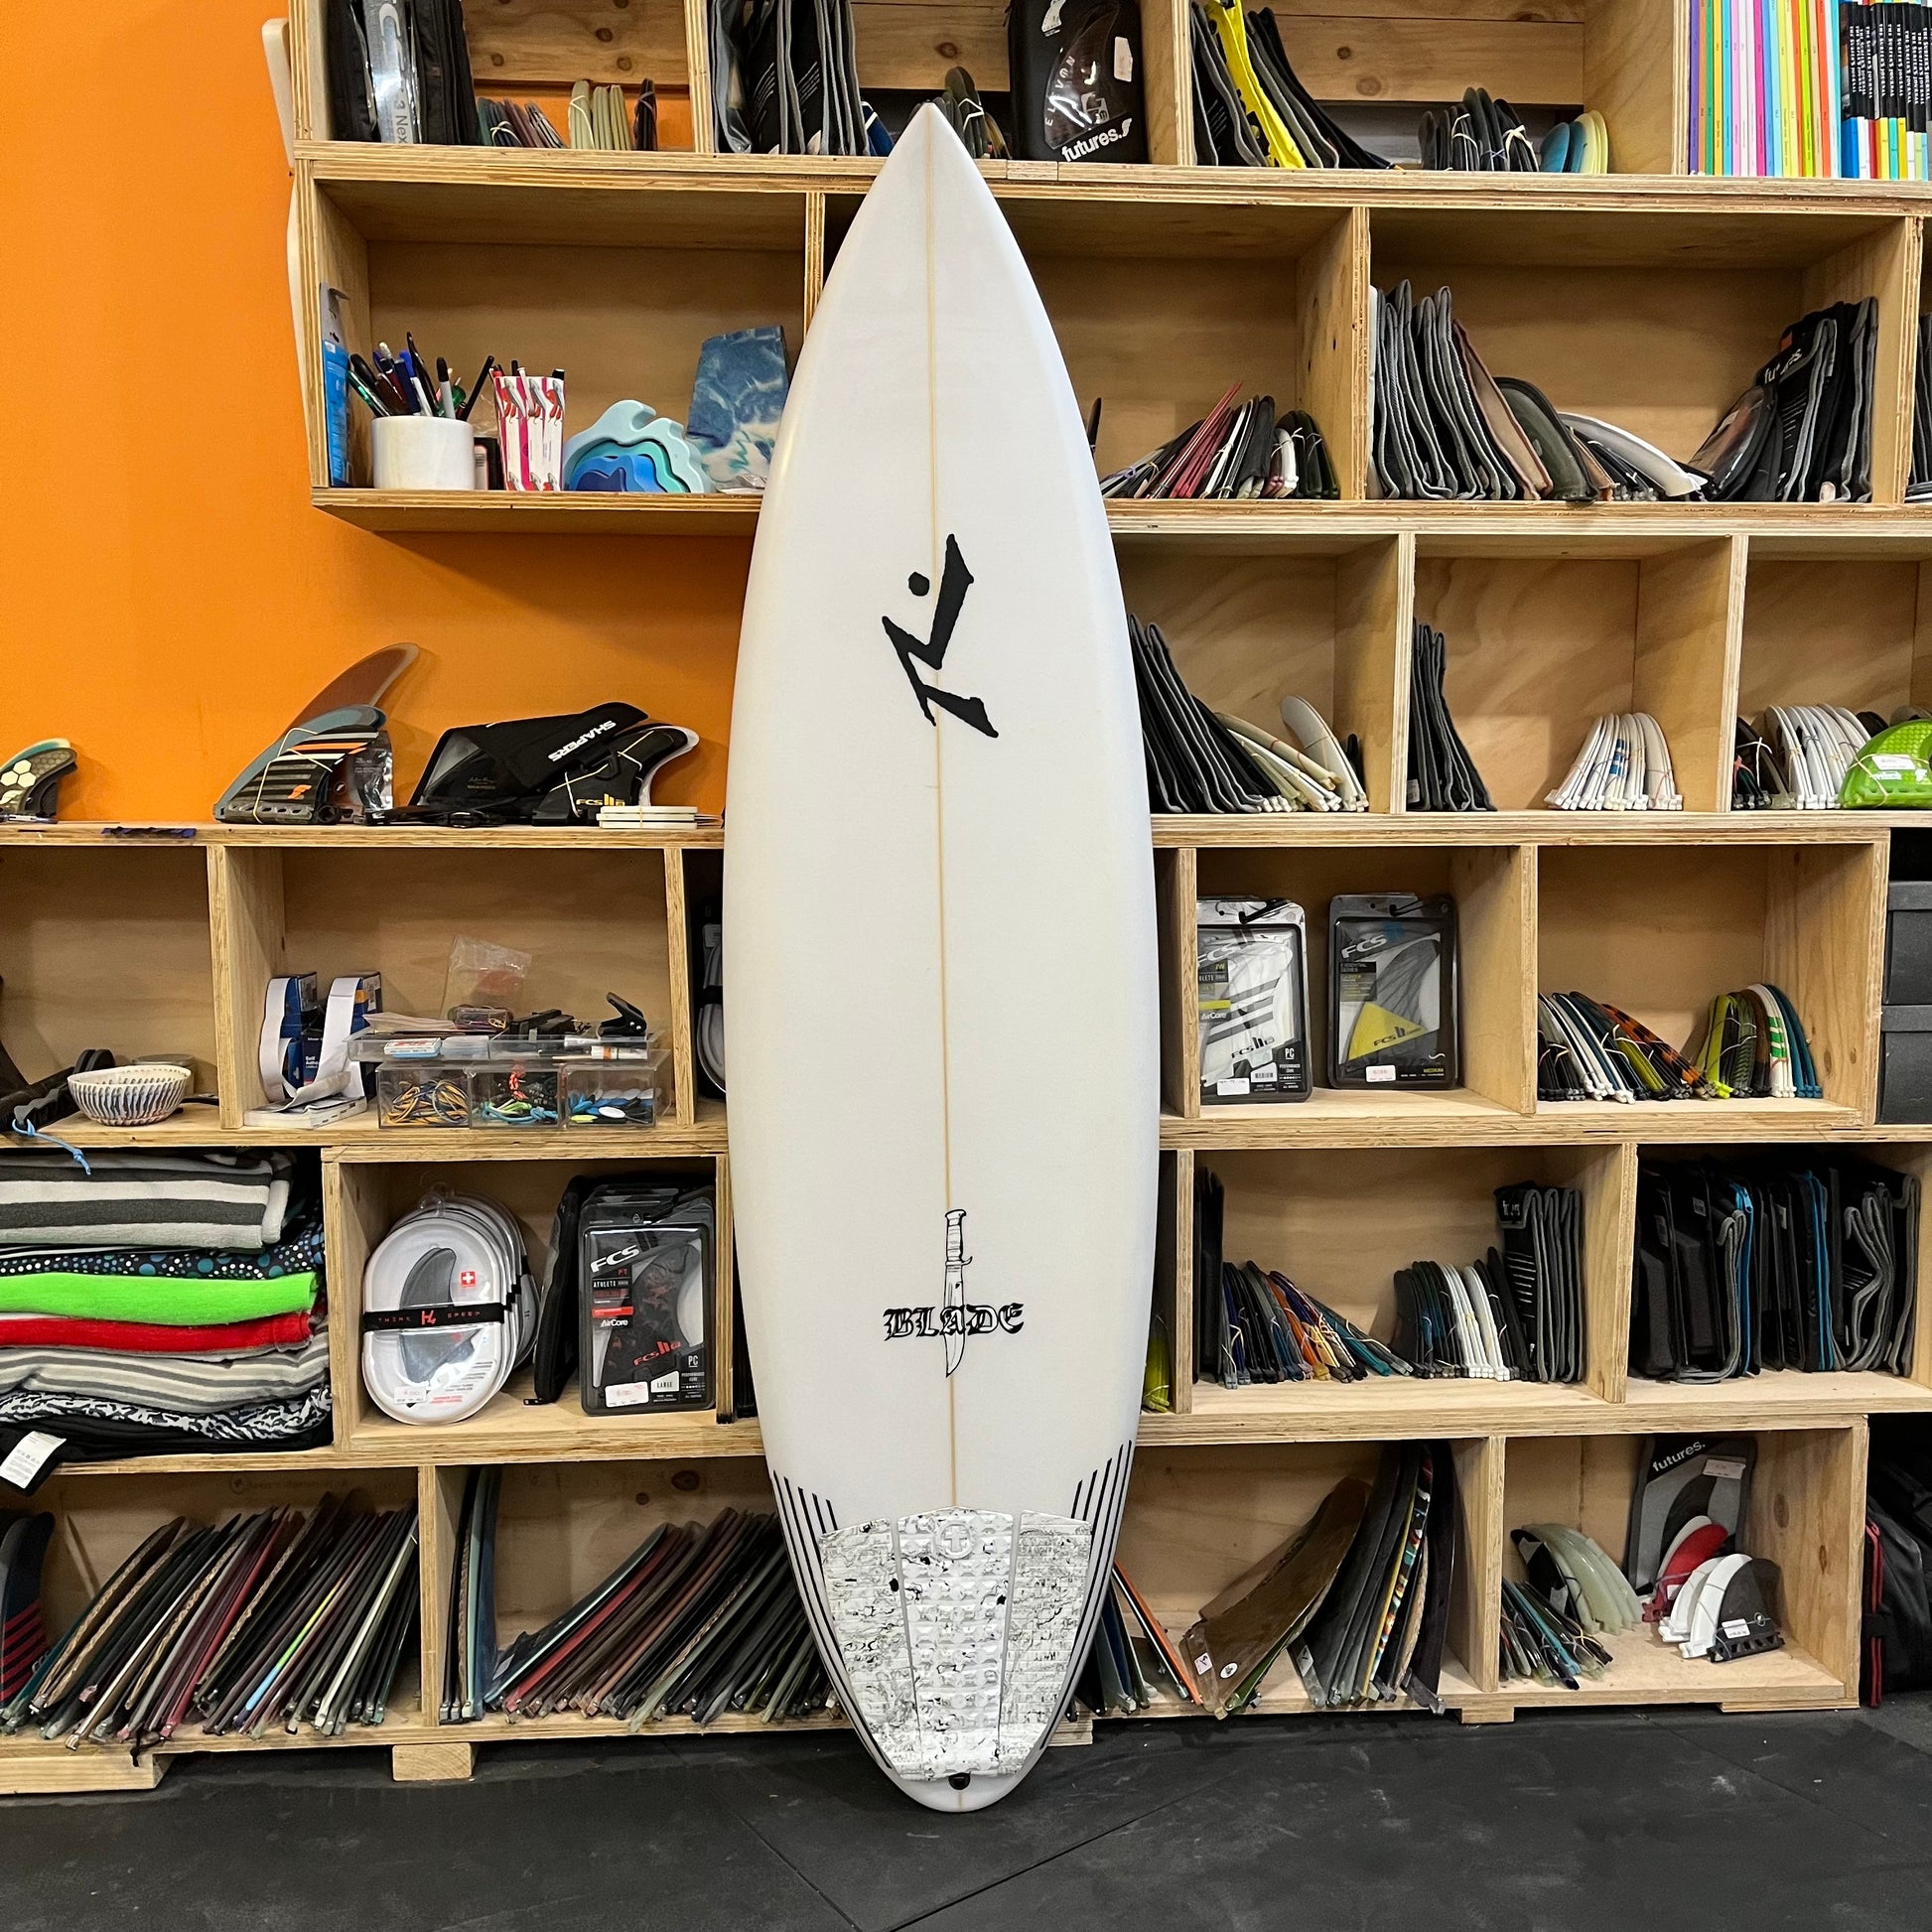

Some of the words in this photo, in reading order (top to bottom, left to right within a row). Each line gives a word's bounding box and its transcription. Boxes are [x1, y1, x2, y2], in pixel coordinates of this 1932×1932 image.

[1044, 56, 1076, 127] ELVON
[548, 720, 617, 762] SHAPERS
[1341, 934, 1387, 959] FCS
[1201, 1012, 1226, 1021] AirCore
[1374, 1035, 1396, 1046] FCS
[1231, 1045, 1254, 1058] FCS
[1285, 1047, 1295, 1058] PC
[590, 1245, 639, 1273] FCS
[600, 1318, 628, 1327] AirCore
[883, 1303, 1024, 1341] BLADE
[633, 1351, 659, 1366] FCS
[688, 1355, 698, 1366] PC
[1652, 1441, 1706, 1472] futures.
